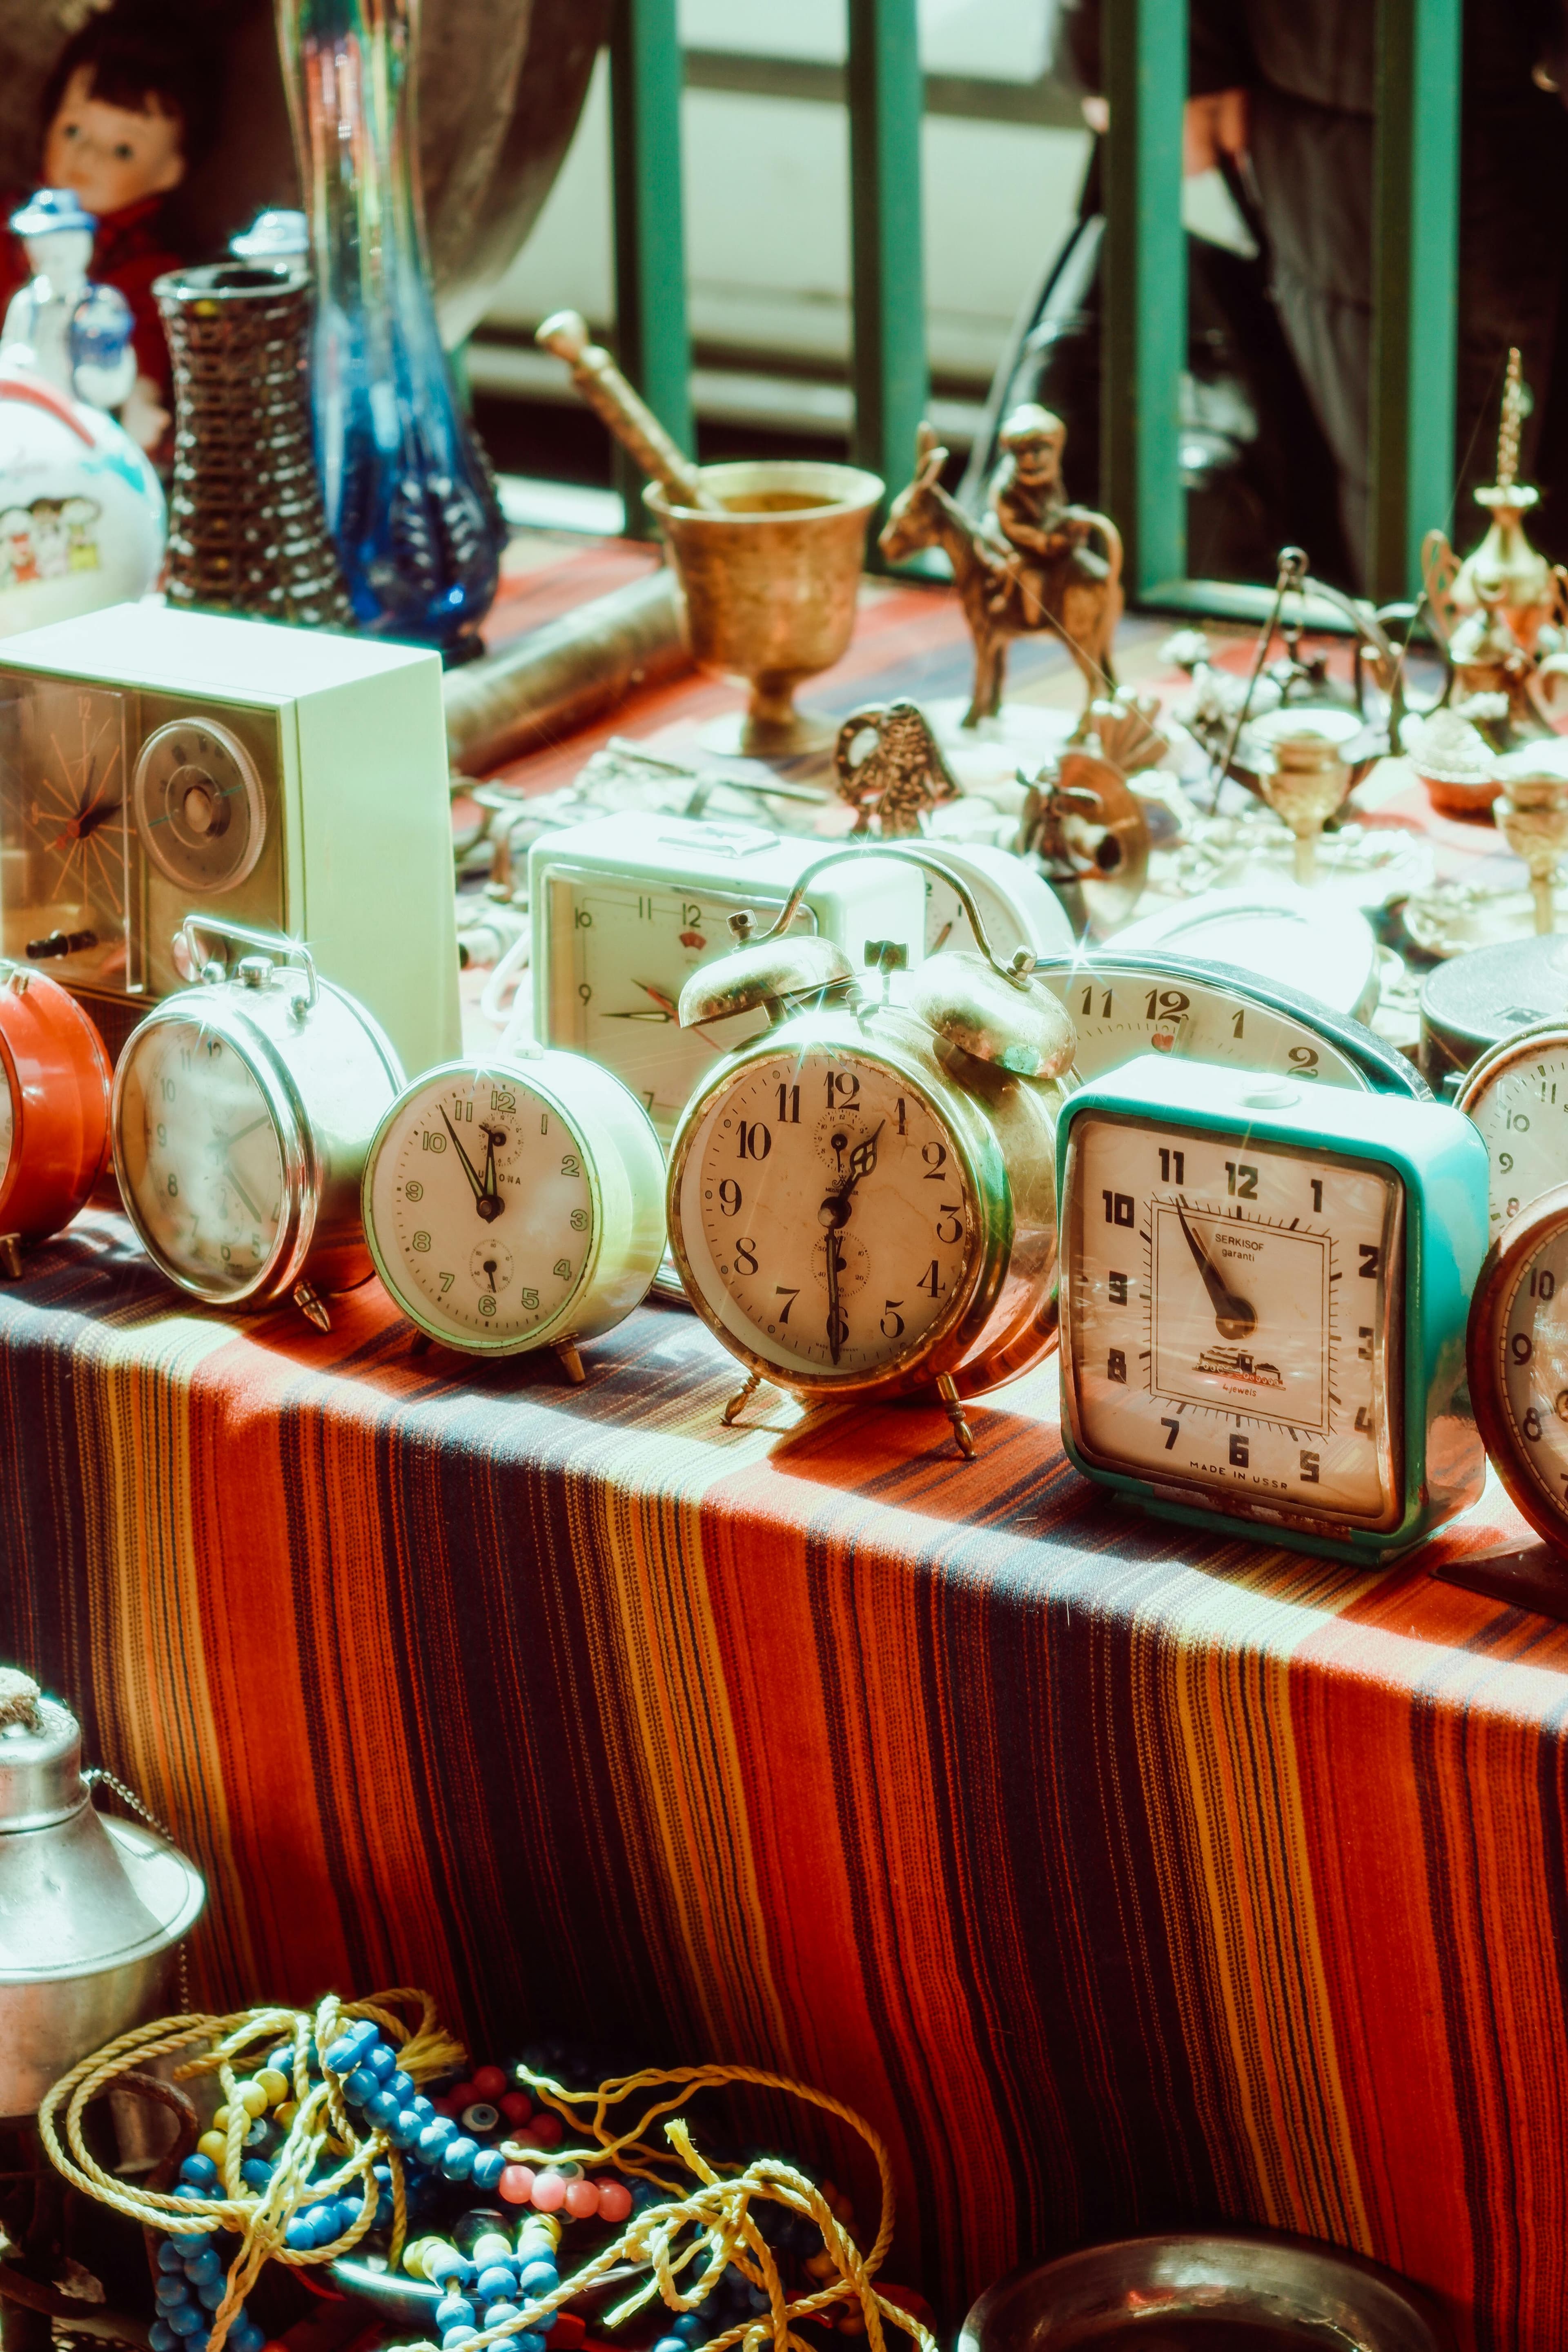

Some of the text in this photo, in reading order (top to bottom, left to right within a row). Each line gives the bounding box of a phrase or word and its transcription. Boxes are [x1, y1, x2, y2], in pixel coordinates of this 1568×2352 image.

[575, 907, 592, 929] 10
[639, 896, 652, 920] 11
[683, 903, 701, 928] 12
[578, 983, 592, 1006] 9
[1082, 986, 1112, 1018] 11
[1145, 988, 1190, 1023] 12
[1231, 1009, 1244, 1039] 1
[1287, 1046, 1319, 1079] 2
[160, 1078, 176, 1102] 10
[491, 1091, 516, 1113] 12
[775, 1083, 801, 1124] 11
[823, 1071, 860, 1111] 12
[1541, 1082, 1556, 1104] 11
[455, 1100, 472, 1122] 11
[541, 1114, 548, 1135] 1
[894, 1098, 909, 1135] 1
[1506, 1109, 1530, 1132] 10
[156, 1123, 167, 1147] 9
[423, 1131, 446, 1153] 10
[736, 1121, 771, 1160] 10
[561, 1155, 579, 1177] 2
[921, 1142, 946, 1180] 2
[1158, 1148, 1184, 1185] 11
[1499, 1153, 1513, 1174] 9
[167, 1174, 178, 1196] 8
[406, 1181, 423, 1201] 9
[1225, 1162, 1258, 1200] 12
[1311, 1180, 1323, 1212] 1
[719, 1179, 742, 1216] 9
[1102, 1190, 1134, 1228] 10
[1506, 1197, 1519, 1218] 8
[570, 1209, 587, 1231] 3
[936, 1205, 963, 1243] 3
[252, 1233, 261, 1259] 5
[412, 1231, 431, 1252] 8
[734, 1237, 758, 1275] 8
[1215, 1234, 1264, 1251] SERKISOF
[1222, 1249, 1254, 1262] garanti
[553, 1259, 572, 1281] 4
[1359, 1244, 1379, 1279] 2
[439, 1272, 454, 1292] 7
[917, 1261, 946, 1298] 4
[1109, 1271, 1127, 1306] 9
[1530, 1267, 1555, 1301] 10
[479, 1295, 496, 1316] 6
[521, 1288, 539, 1310] 5
[775, 1286, 800, 1324] 7
[826, 1307, 849, 1344] 6
[880, 1300, 905, 1338] 5
[1512, 1332, 1532, 1366] 9
[1108, 1348, 1126, 1383] 8
[1161, 1417, 1179, 1450] 7
[1523, 1407, 1542, 1442] 8
[1229, 1433, 1249, 1468] 6
[1190, 1461, 1287, 1490] MADE IN USSR
[1300, 1450, 1319, 1483] 5
